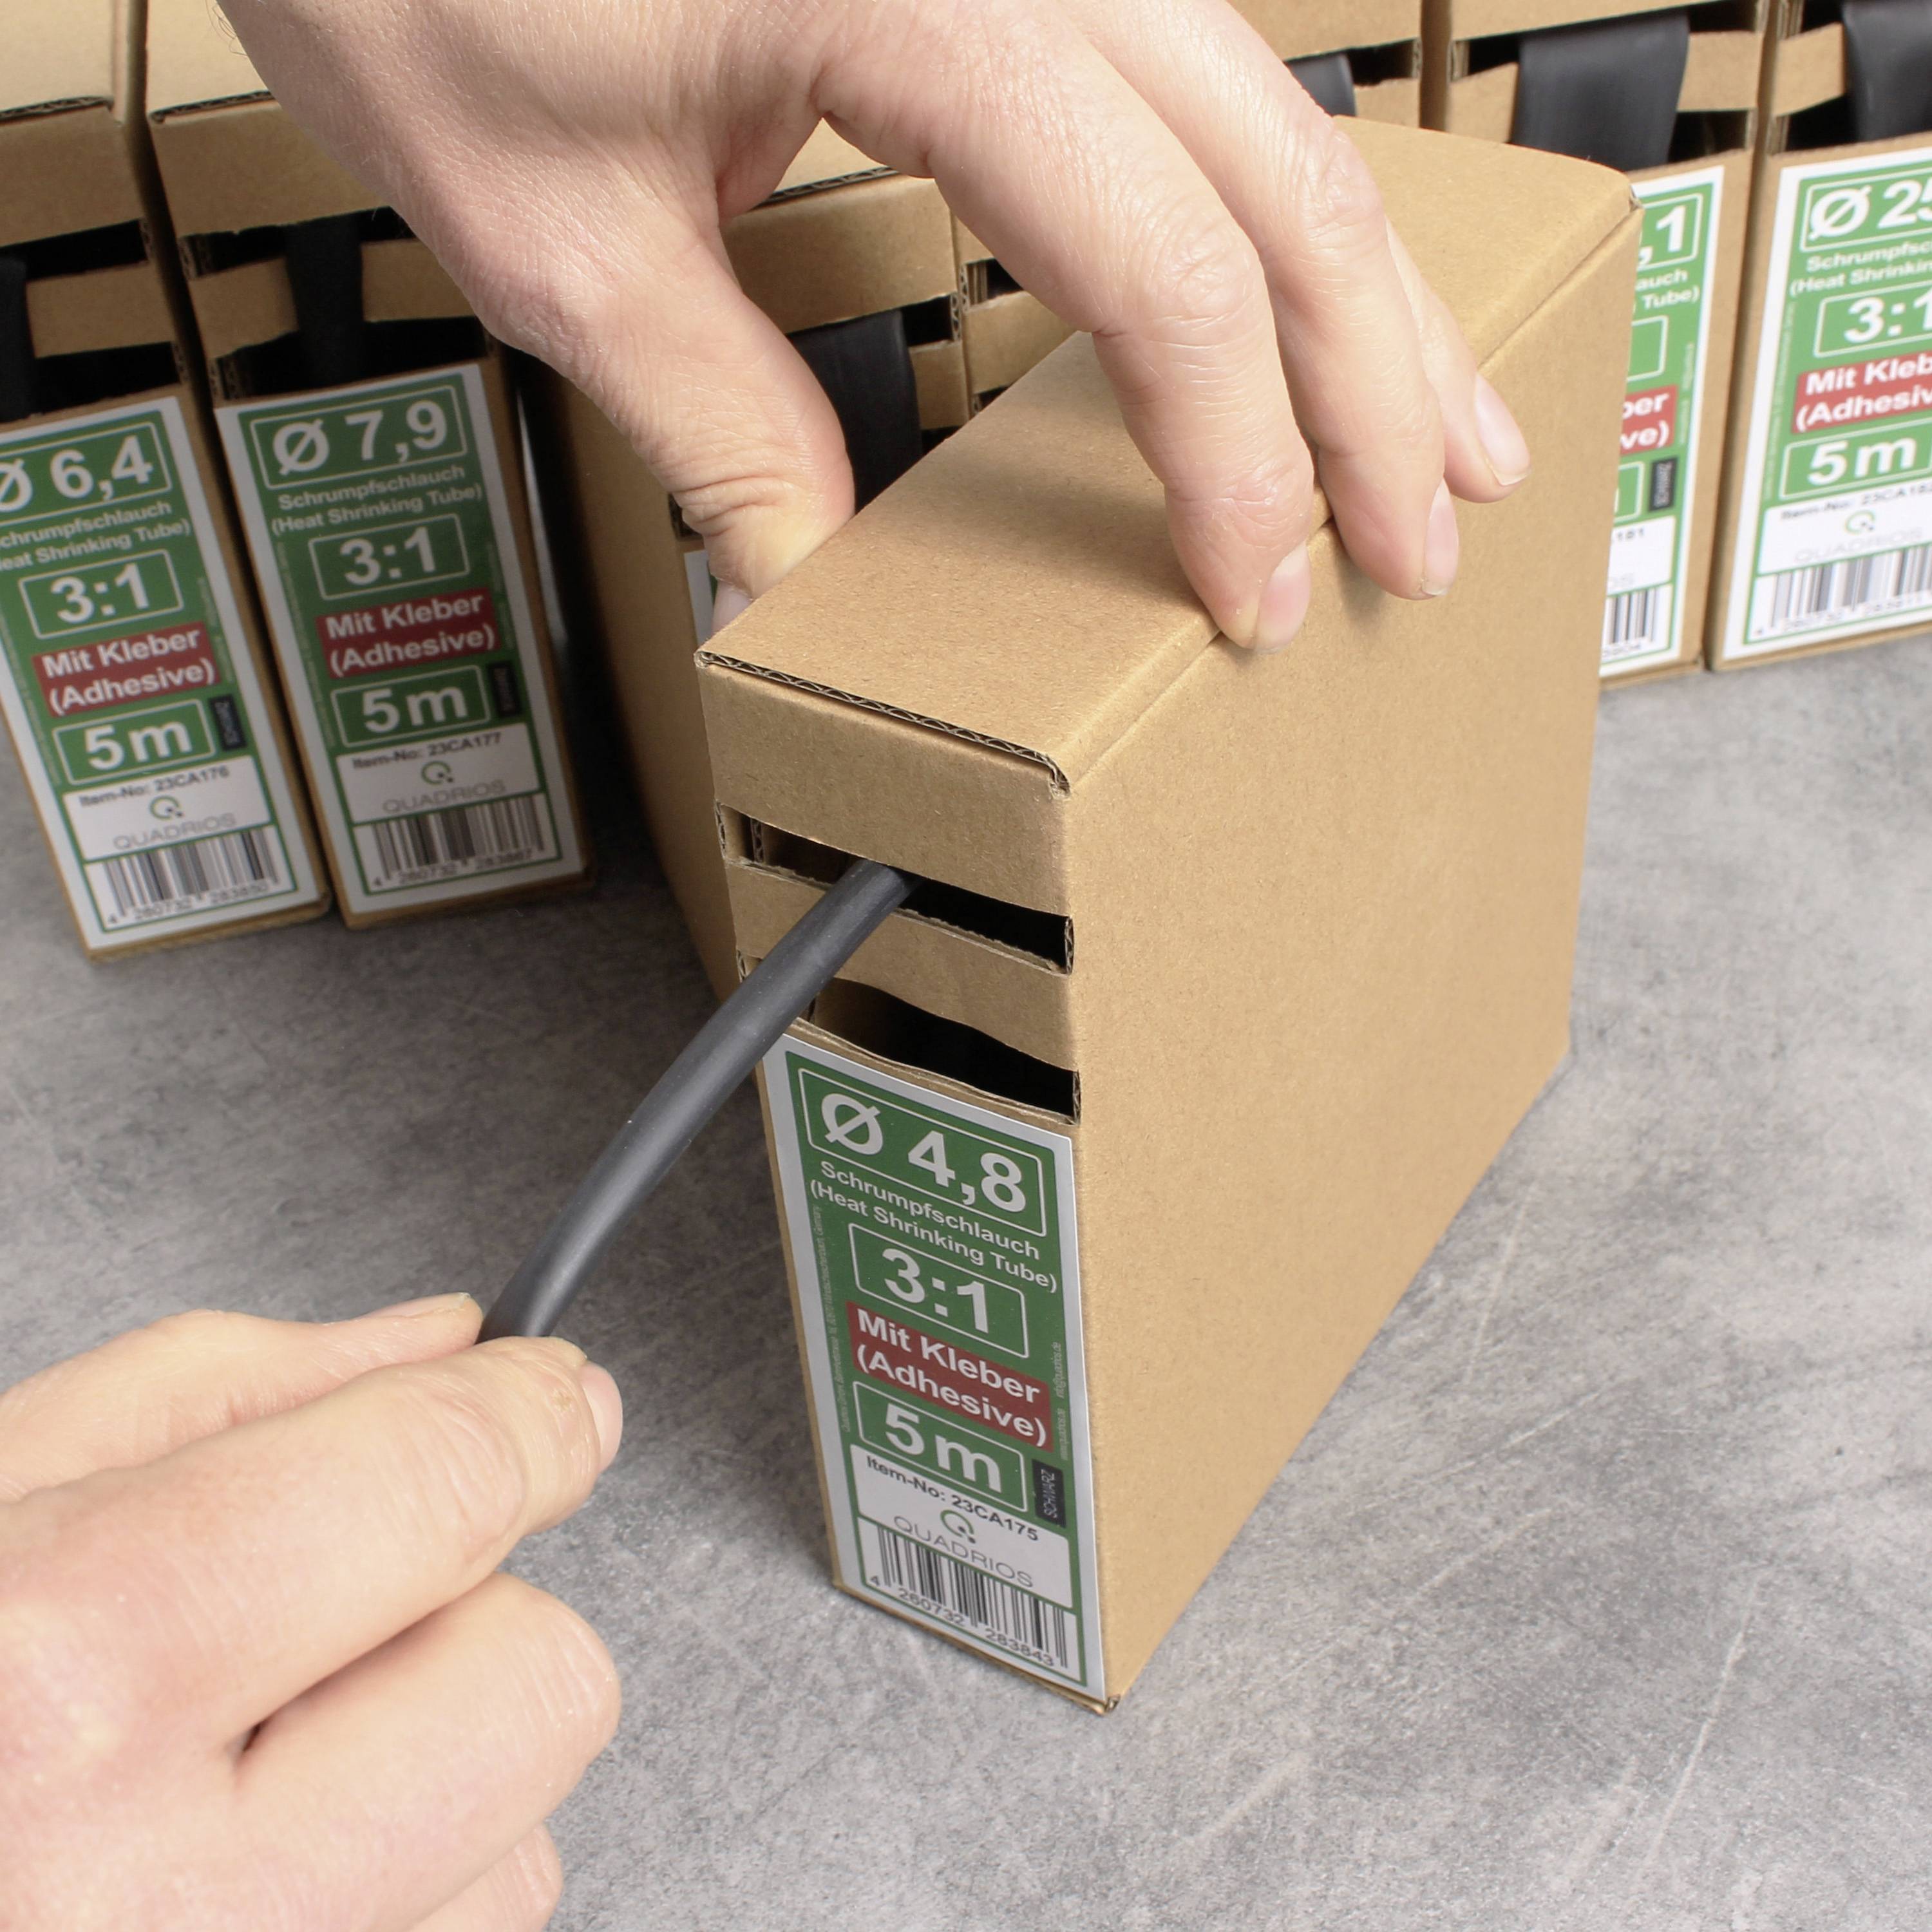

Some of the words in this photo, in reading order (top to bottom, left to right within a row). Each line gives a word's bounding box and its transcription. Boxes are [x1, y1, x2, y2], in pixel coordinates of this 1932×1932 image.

[1790, 273, 1846, 298] (Heat
[1806, 367, 1857, 396] Mit
[345, 400, 448, 463] 7,9
[50, 435, 153, 501] 6,4
[278, 464, 466, 511] Schrumpfschlauch
[271, 512, 323, 536] (Heat
[328, 495, 424, 526] Shrinking
[425, 483, 483, 507] Tube)
[35, 533, 133, 567] Shrinking
[135, 518, 191, 543] Tube)
[339, 527, 437, 586] 3:1
[50, 562, 149, 623] 3:1
[325, 614, 376, 640] Mit
[381, 593, 484, 634] Kleber
[42, 651, 93, 679] Mit
[97, 629, 201, 667] Kleber
[330, 624, 496, 677] (Adhesive)
[49, 658, 215, 715] (Adhesive)
[428, 732, 502, 757] 23CA177
[382, 779, 506, 813] QUADRIOS
[113, 812, 237, 851] QUADRIOS
[907, 1130, 1027, 1213] 4,8
[810, 1179, 869, 1217] (Heat
[873, 1205, 984, 1266] Shrinking
[989, 1251, 1057, 1294] Tube)
[820, 1160, 1040, 1260] Schrumpfschlauch
[882, 1247, 989, 1334] 3:1
[857, 1308, 912, 1353] Mit
[920, 1335, 1041, 1403] Kleber
[857, 1343, 1046, 1448] (Adhesive)
[867, 1455, 946, 1502] Item-No:
[951, 1493, 1039, 1542] 23CA175
[1040, 1468, 1058, 1519] SCHWARZ
[894, 1515, 1034, 1588] QUADRIOS
[869, 1575, 880, 1587] 4
[984, 1628, 1055, 1668] 283843
